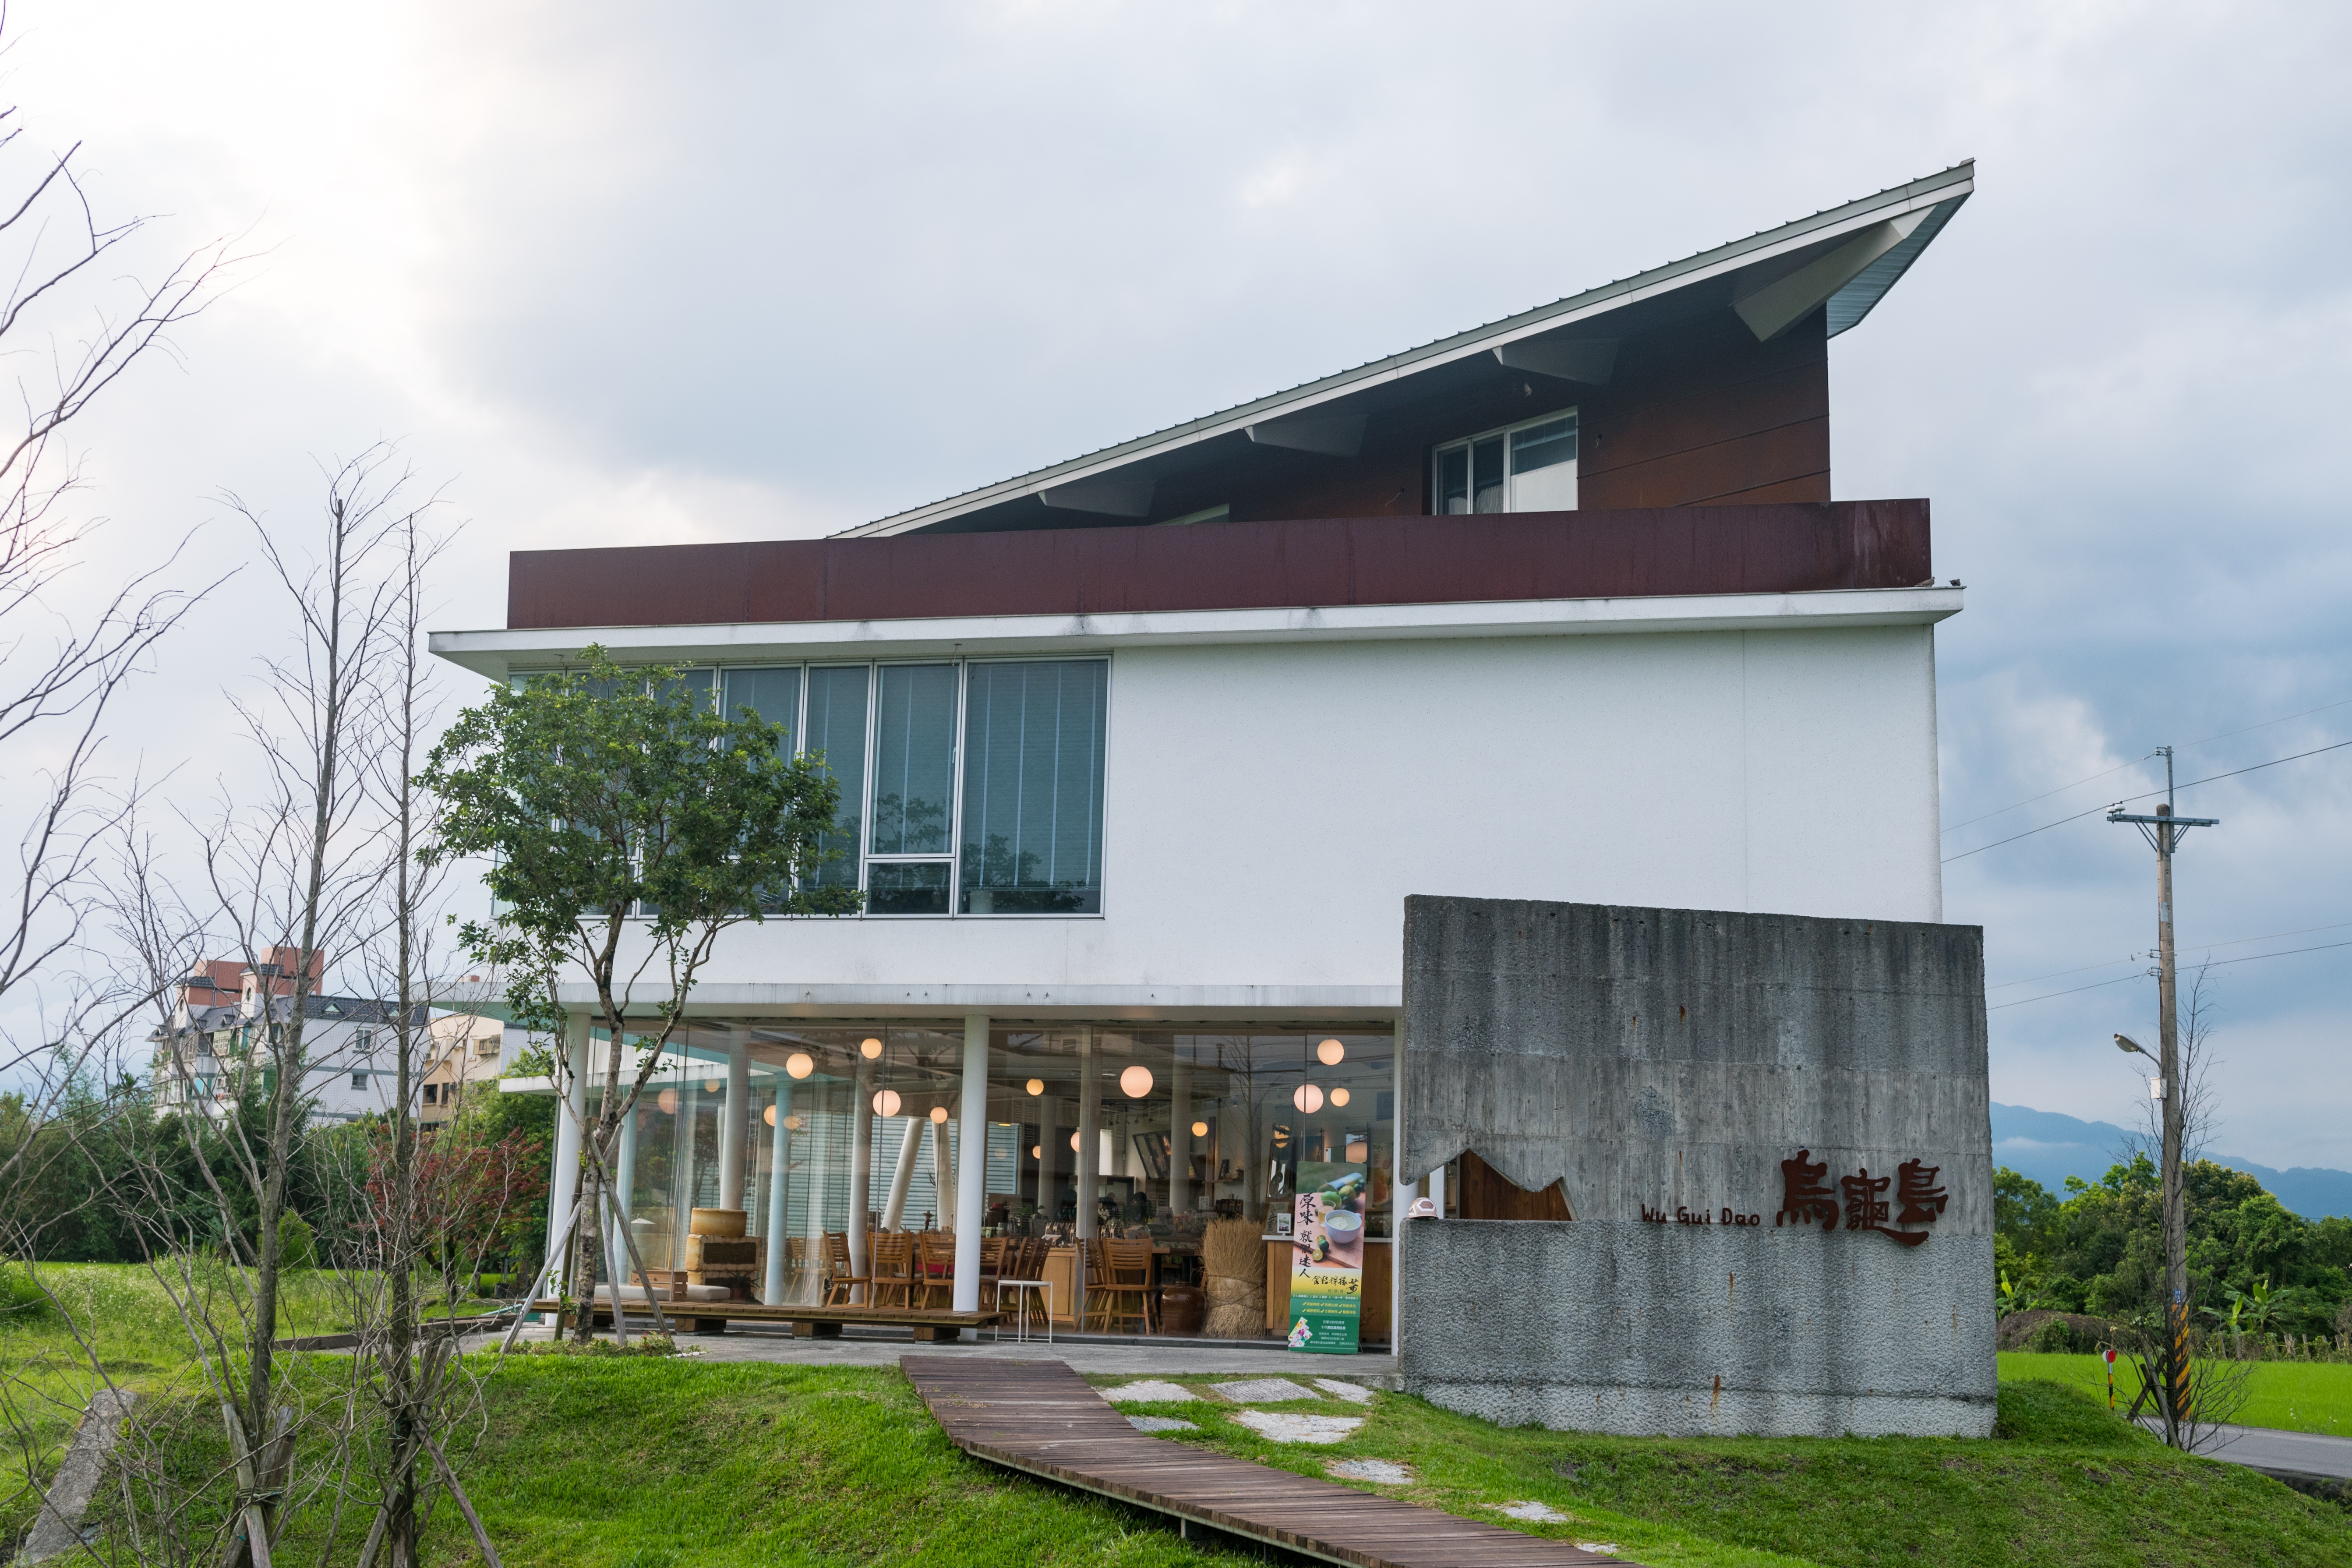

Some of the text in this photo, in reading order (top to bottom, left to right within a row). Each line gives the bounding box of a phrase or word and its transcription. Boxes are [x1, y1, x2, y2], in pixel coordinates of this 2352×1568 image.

[1641, 1203, 1760, 1227] Wu Gui Dao
[1776, 1149, 1949, 1247] 烏龜島
[1297, 1192, 1316, 1278] 原味 就很迷人
[1312, 1275, 1359, 1294] 金桔檸檬茶
